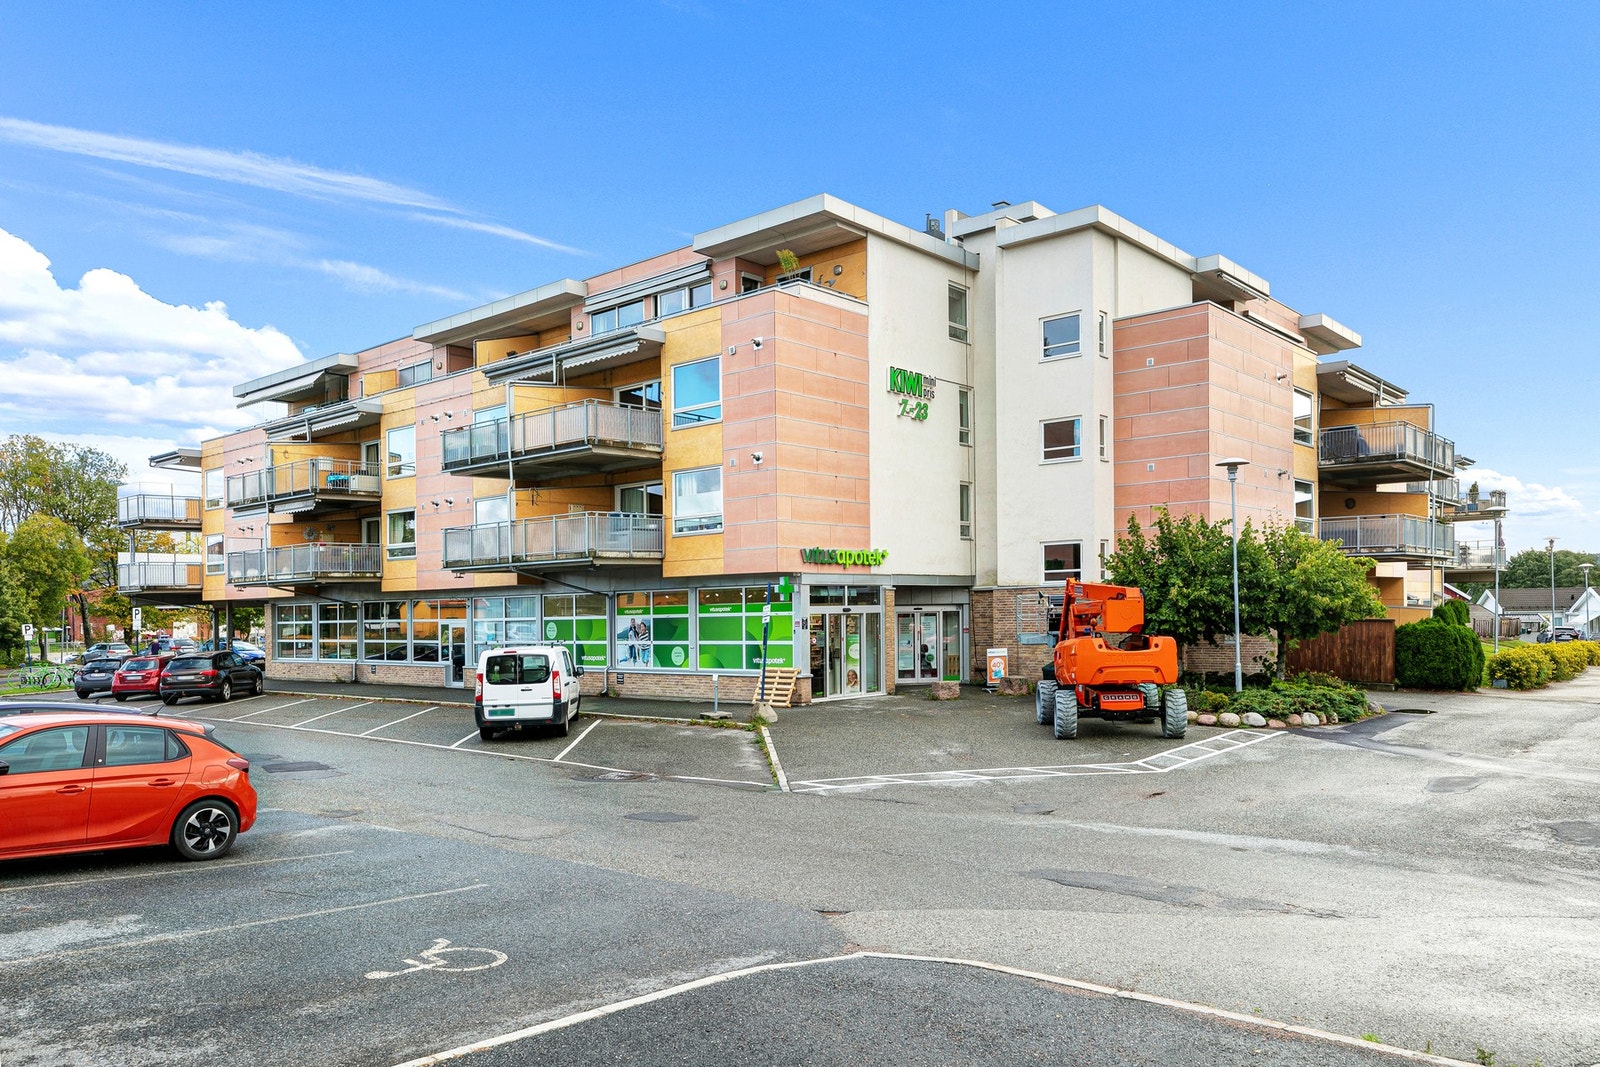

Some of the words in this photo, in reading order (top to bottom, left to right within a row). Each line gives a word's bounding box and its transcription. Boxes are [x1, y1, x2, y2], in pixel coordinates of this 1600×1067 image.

[889, 366, 922, 397] KIWI
[923, 387, 935, 399] pris
[134, 609, 140, 619] P
[25, 626, 31, 635] P
